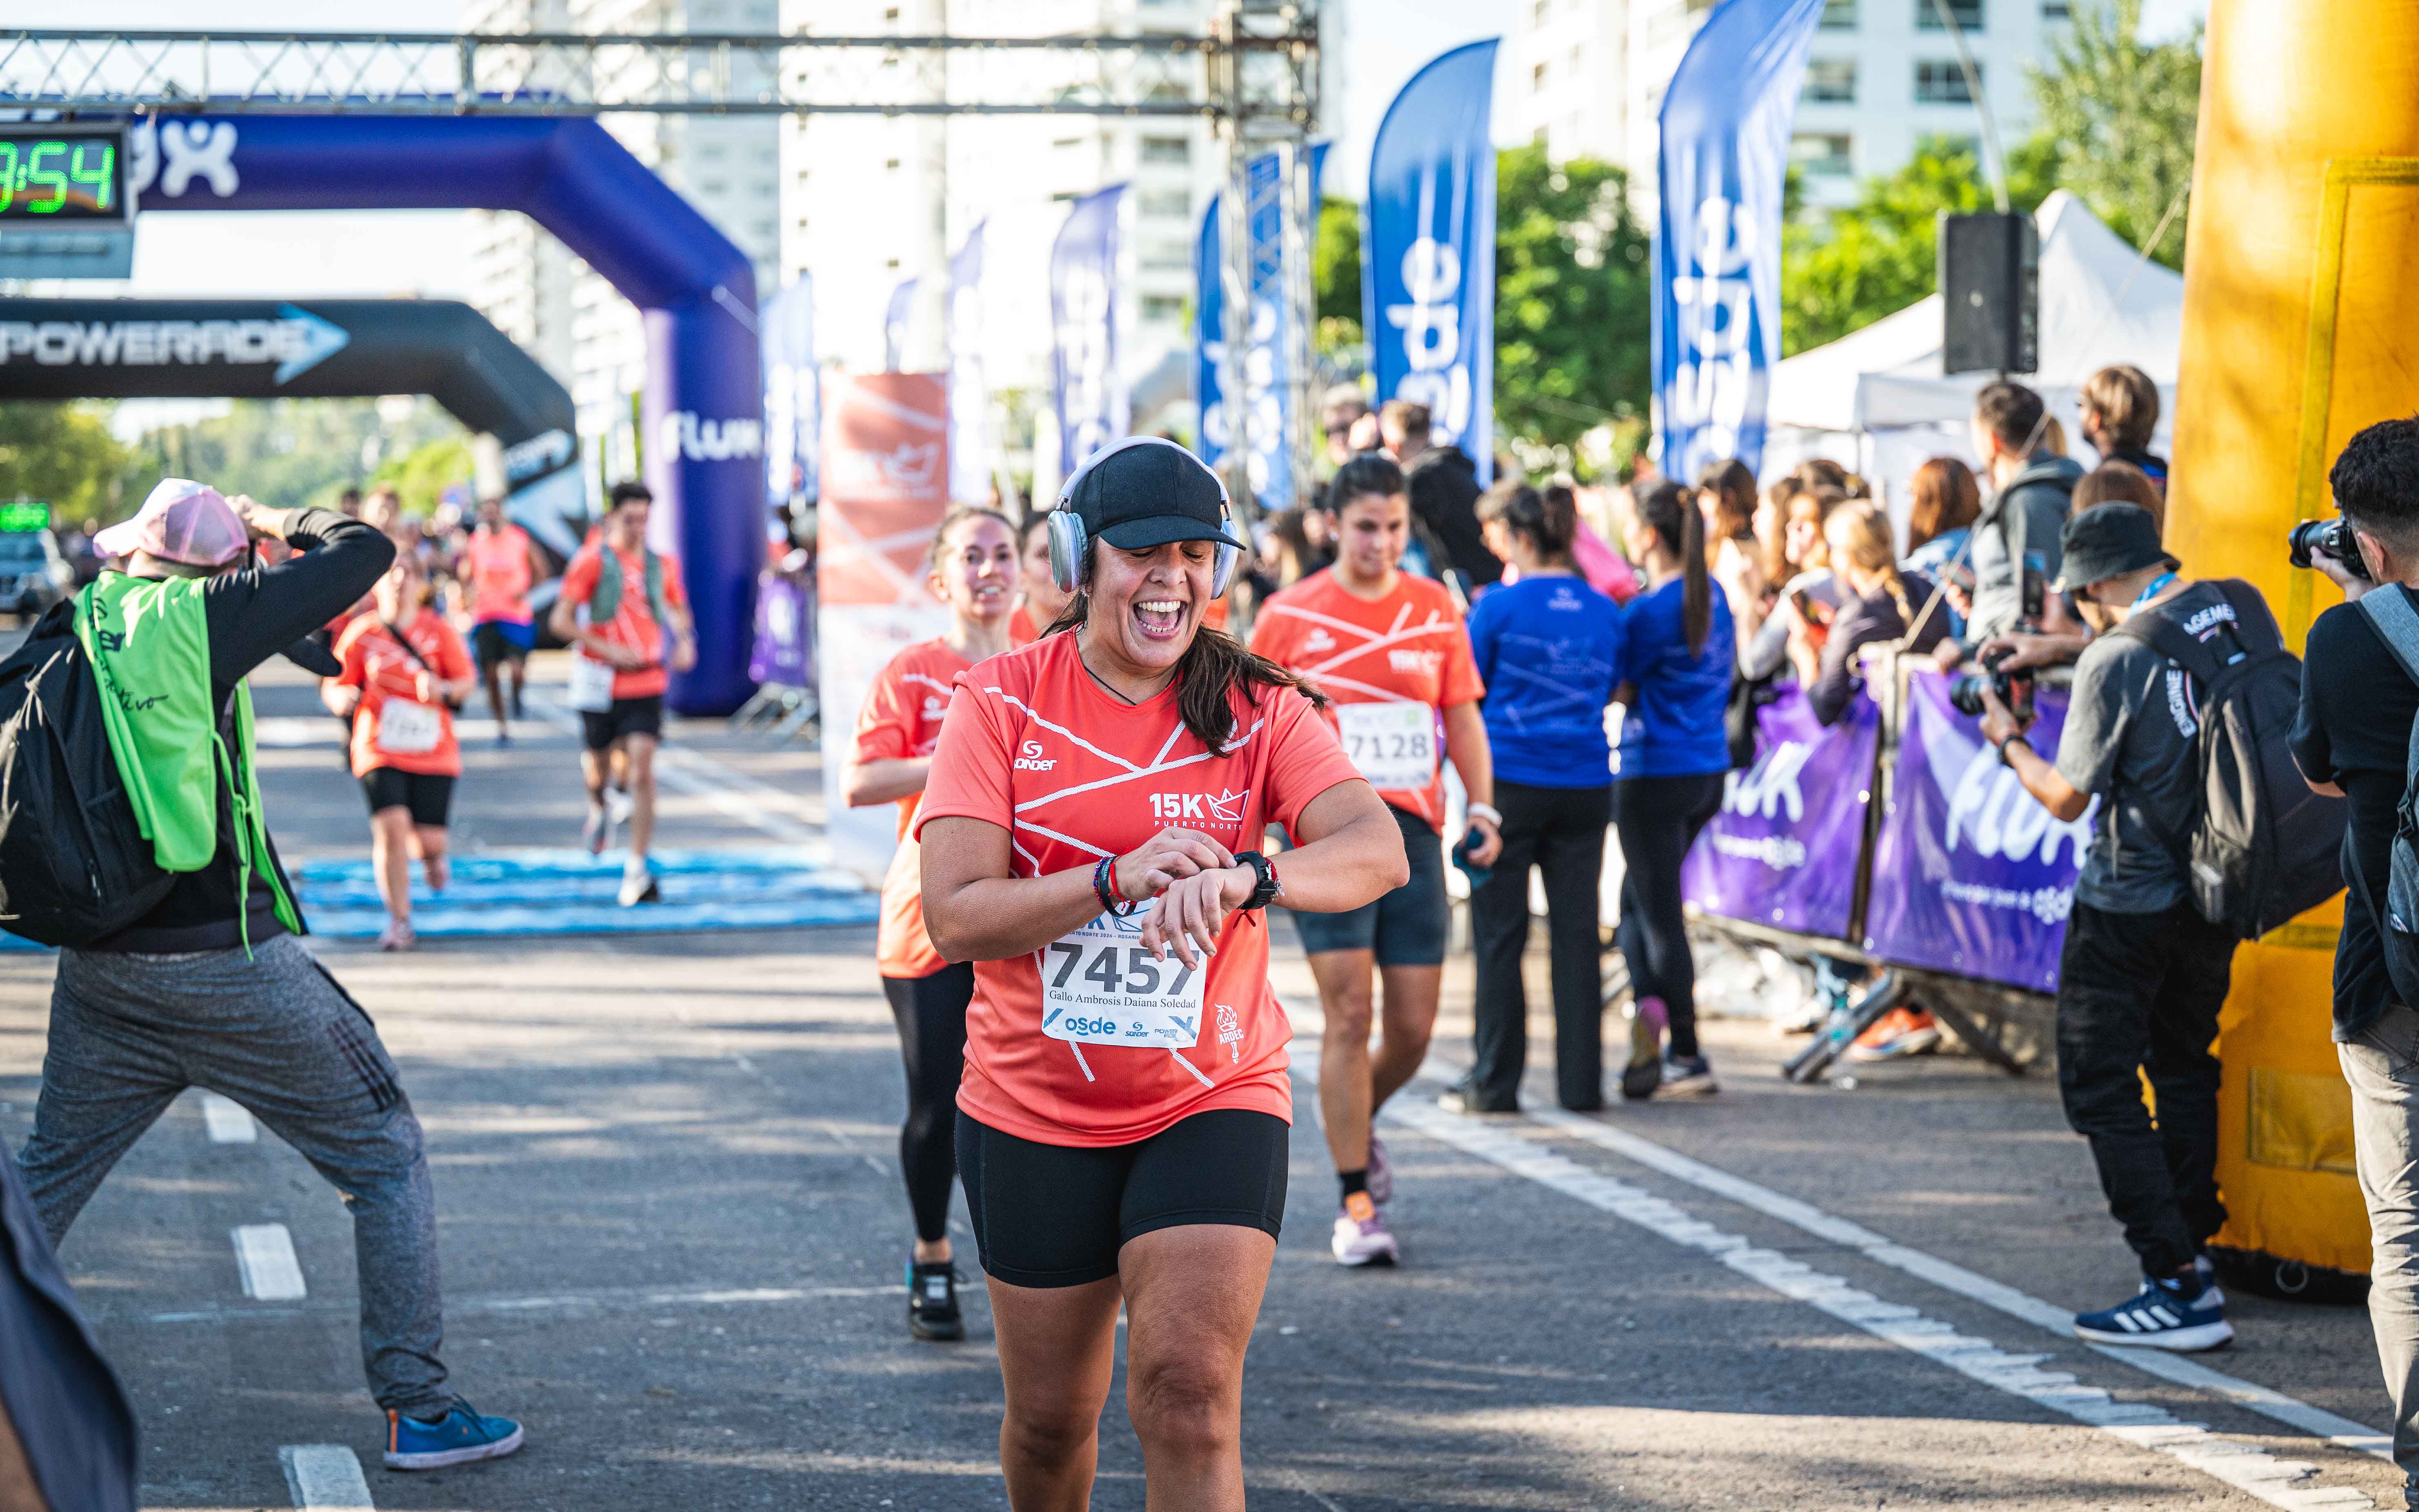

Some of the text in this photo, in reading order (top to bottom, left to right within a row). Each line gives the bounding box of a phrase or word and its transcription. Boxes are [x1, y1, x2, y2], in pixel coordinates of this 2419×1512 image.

[1348, 733, 1428, 759] 7128
[1149, 793, 1205, 819] 15K
[1051, 942, 1200, 995] 7457
[1049, 990, 1196, 1008] Gallo Ambrosis Daiana Soledad
[1065, 1017, 1116, 1036] osde
[1219, 1028, 1244, 1045] ARDEC
